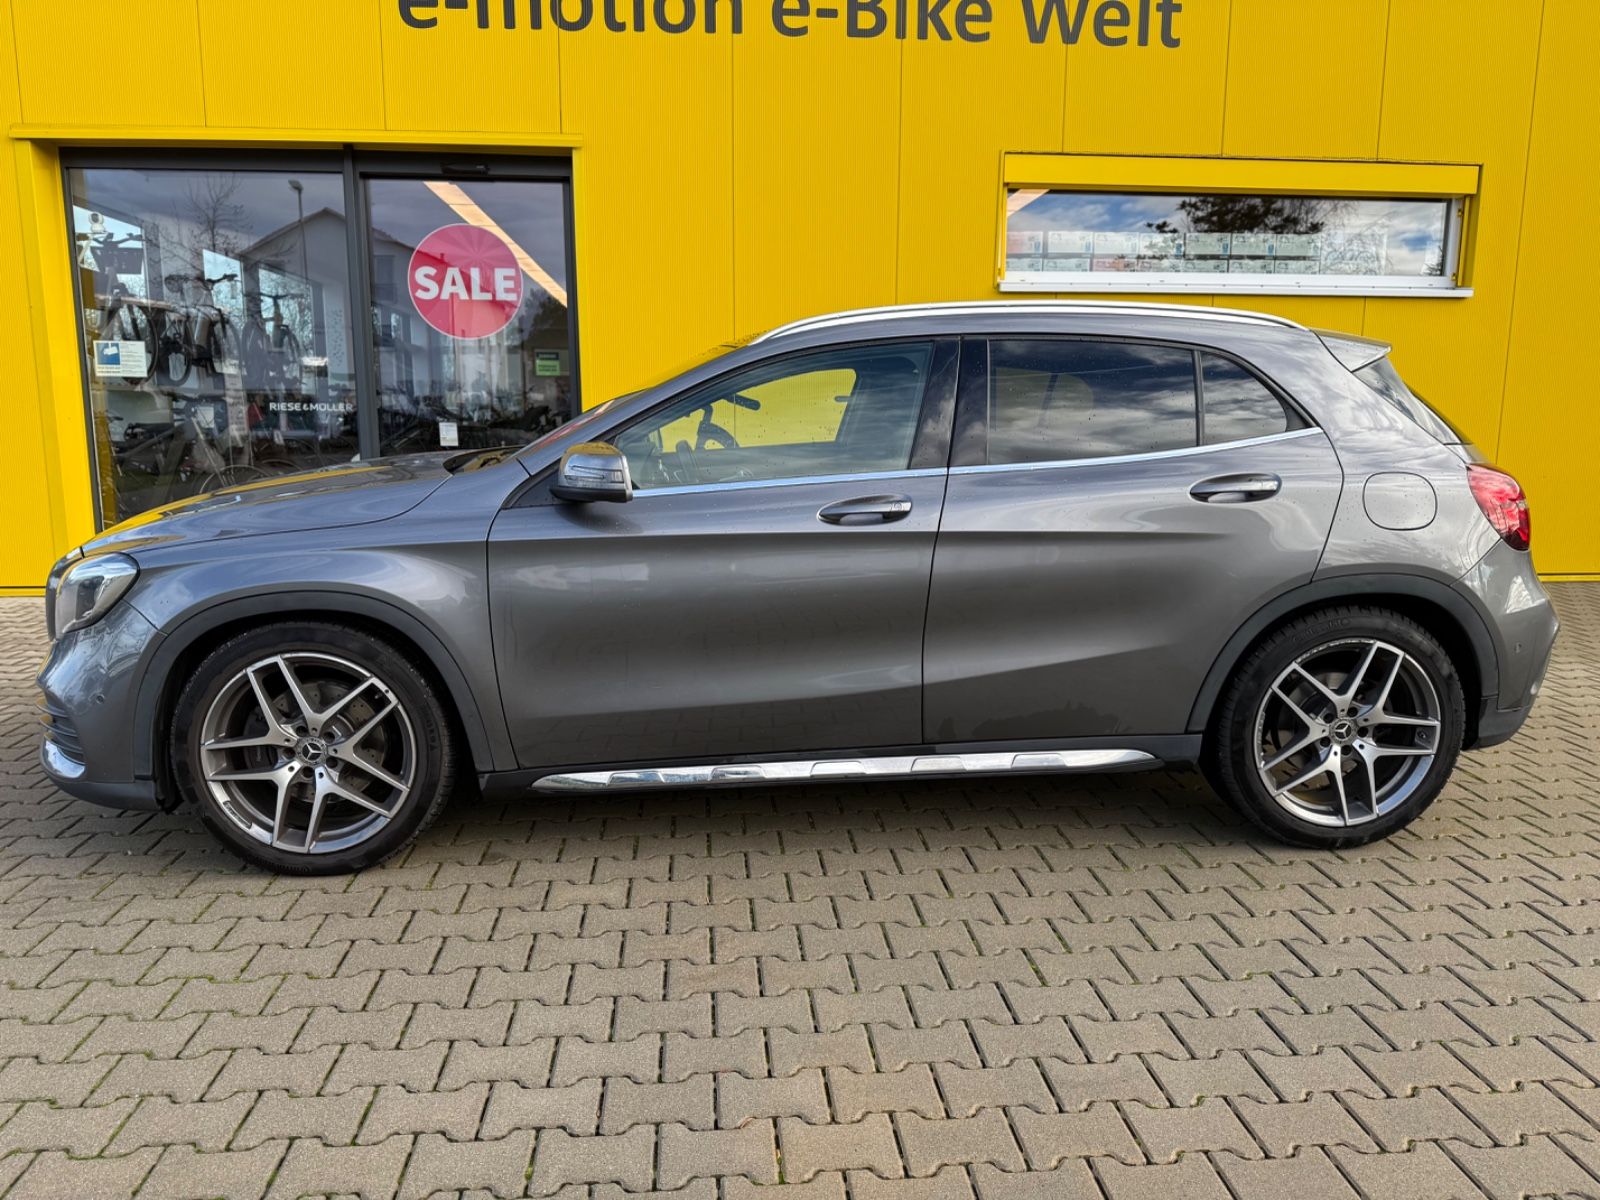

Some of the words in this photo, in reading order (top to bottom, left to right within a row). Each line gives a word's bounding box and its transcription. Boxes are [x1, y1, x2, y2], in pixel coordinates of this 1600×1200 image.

[771, 0, 992, 43] e-Bike
[1022, 0, 1183, 48] Welt
[414, 265, 518, 301] SALE
